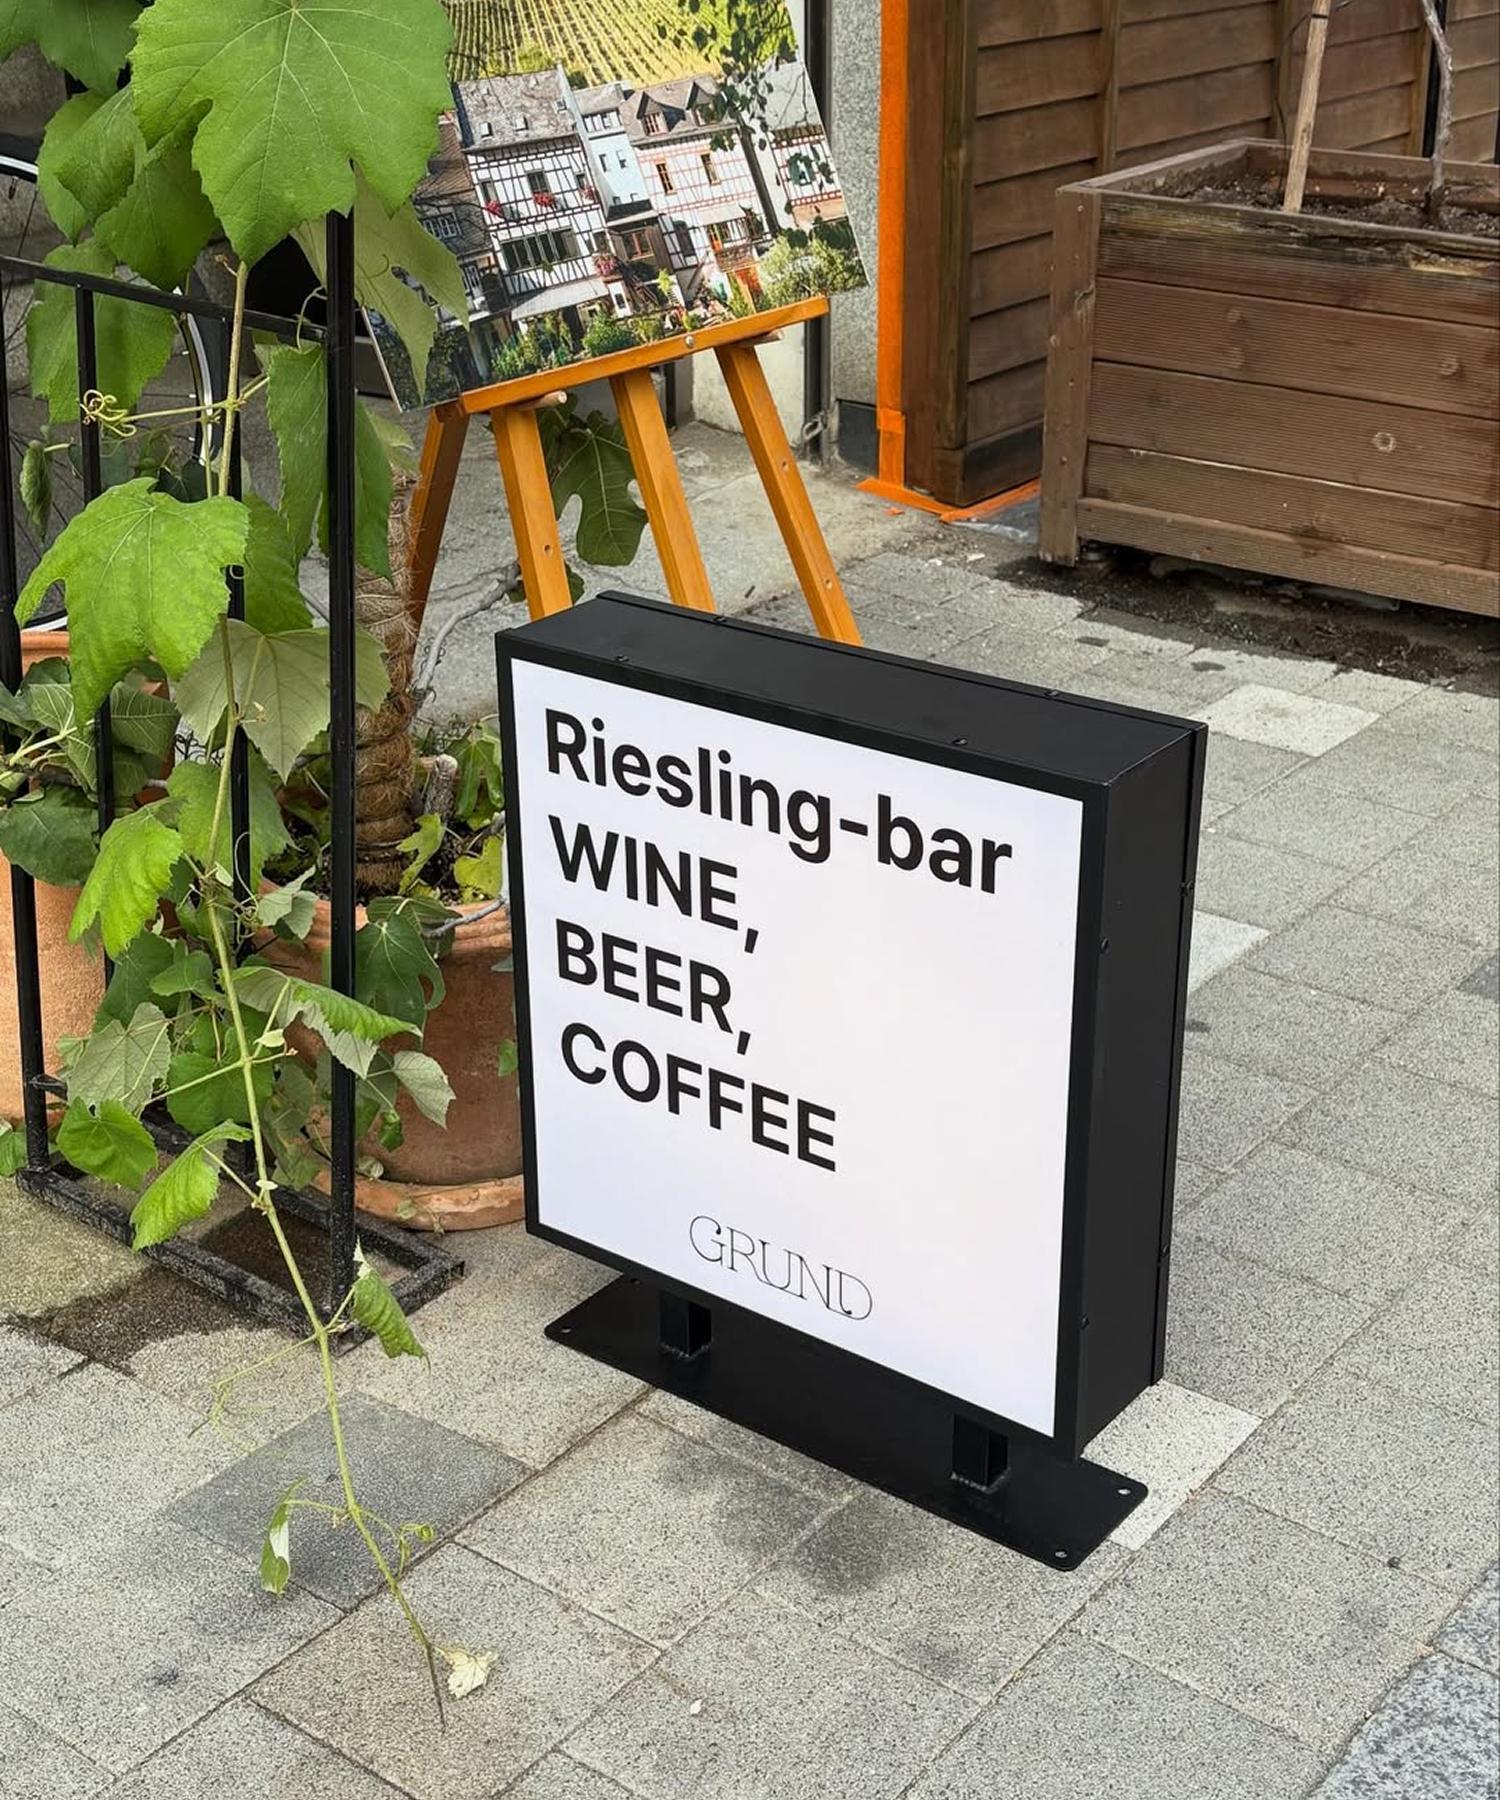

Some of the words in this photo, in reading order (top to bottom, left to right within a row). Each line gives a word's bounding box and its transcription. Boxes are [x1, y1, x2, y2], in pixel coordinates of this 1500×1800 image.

[545, 707, 1013, 895] Riesling-bar
[547, 814, 759, 954] WINE,
[555, 918, 751, 1056] BEER,
[560, 1022, 836, 1173] COFFEE
[689, 1215, 873, 1321] GRUND
